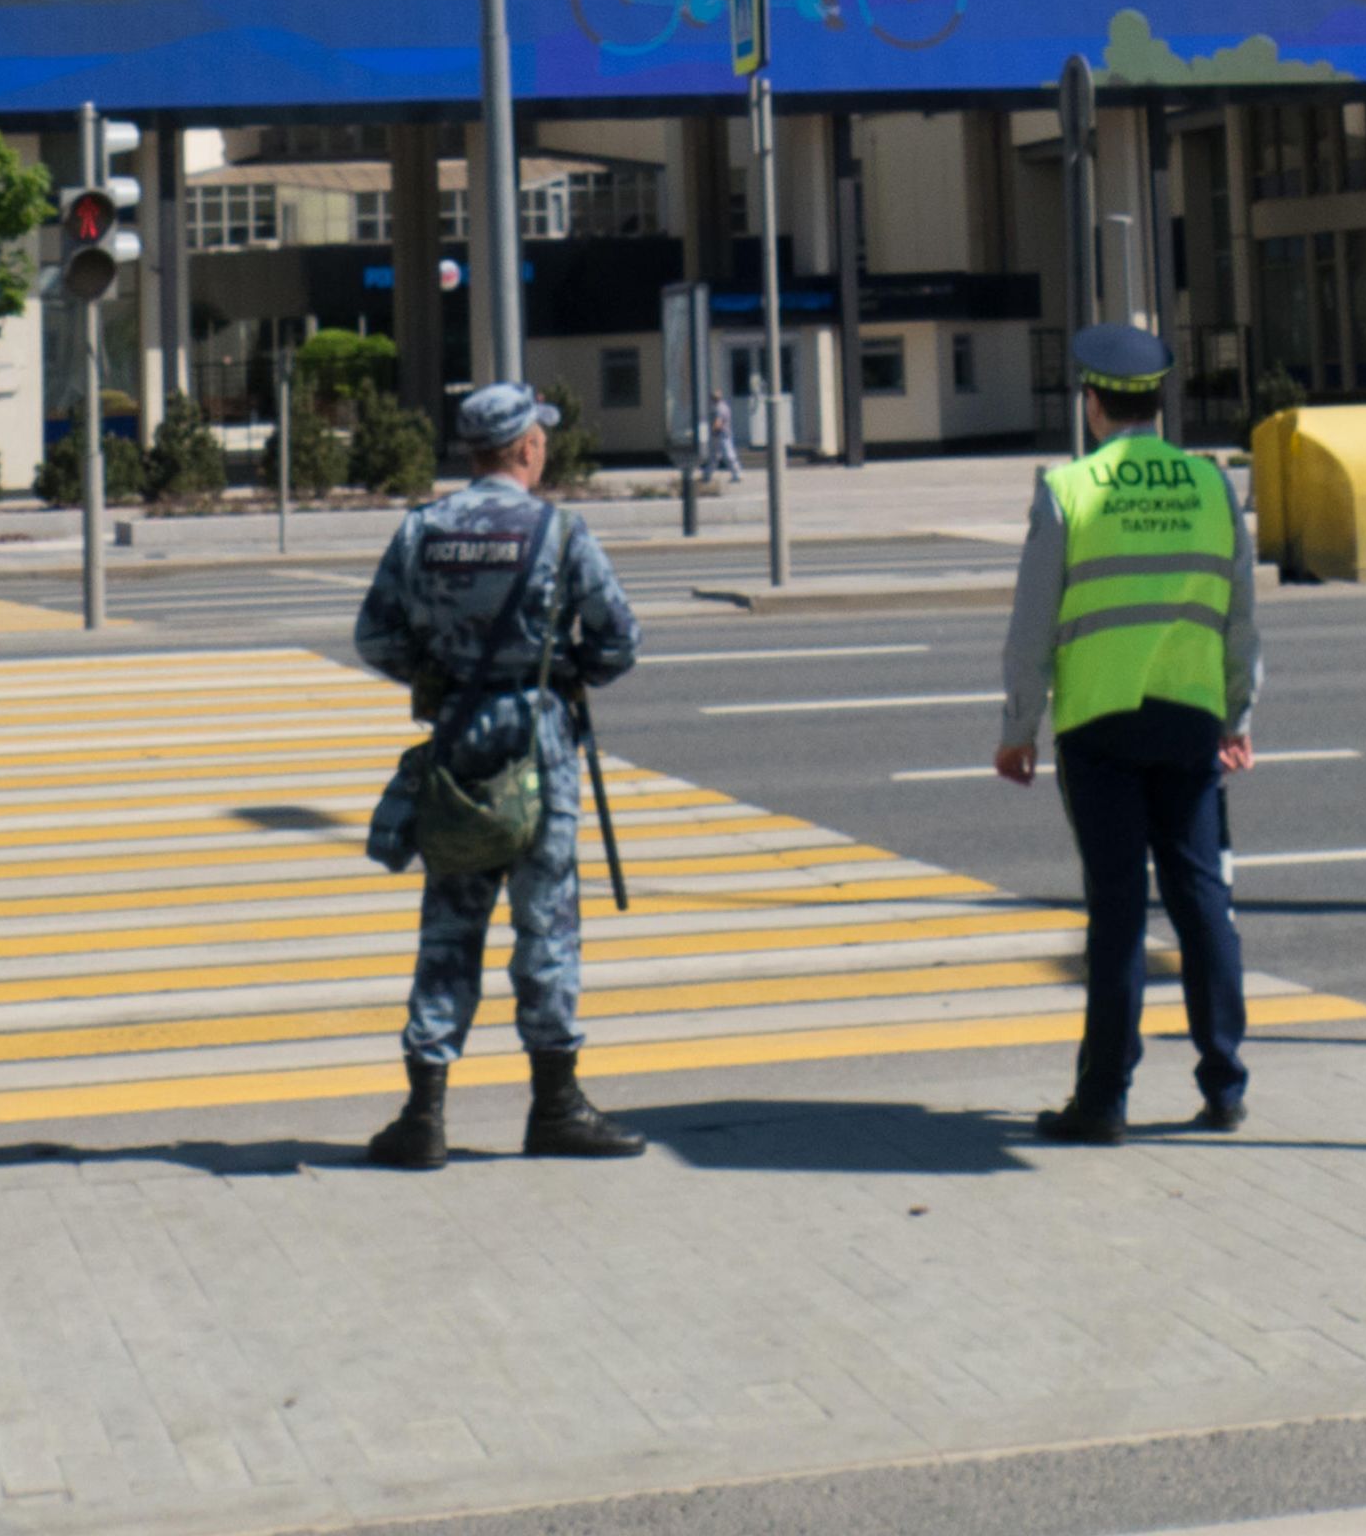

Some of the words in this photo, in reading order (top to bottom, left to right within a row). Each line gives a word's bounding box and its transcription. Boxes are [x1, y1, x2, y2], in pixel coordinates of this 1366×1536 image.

[1089, 460, 1197, 490] ЦОДД
[1103, 495, 1203, 514] ДОРОЖНЫЙ
[1121, 518, 1193, 533] ПАТРУЛЬ
